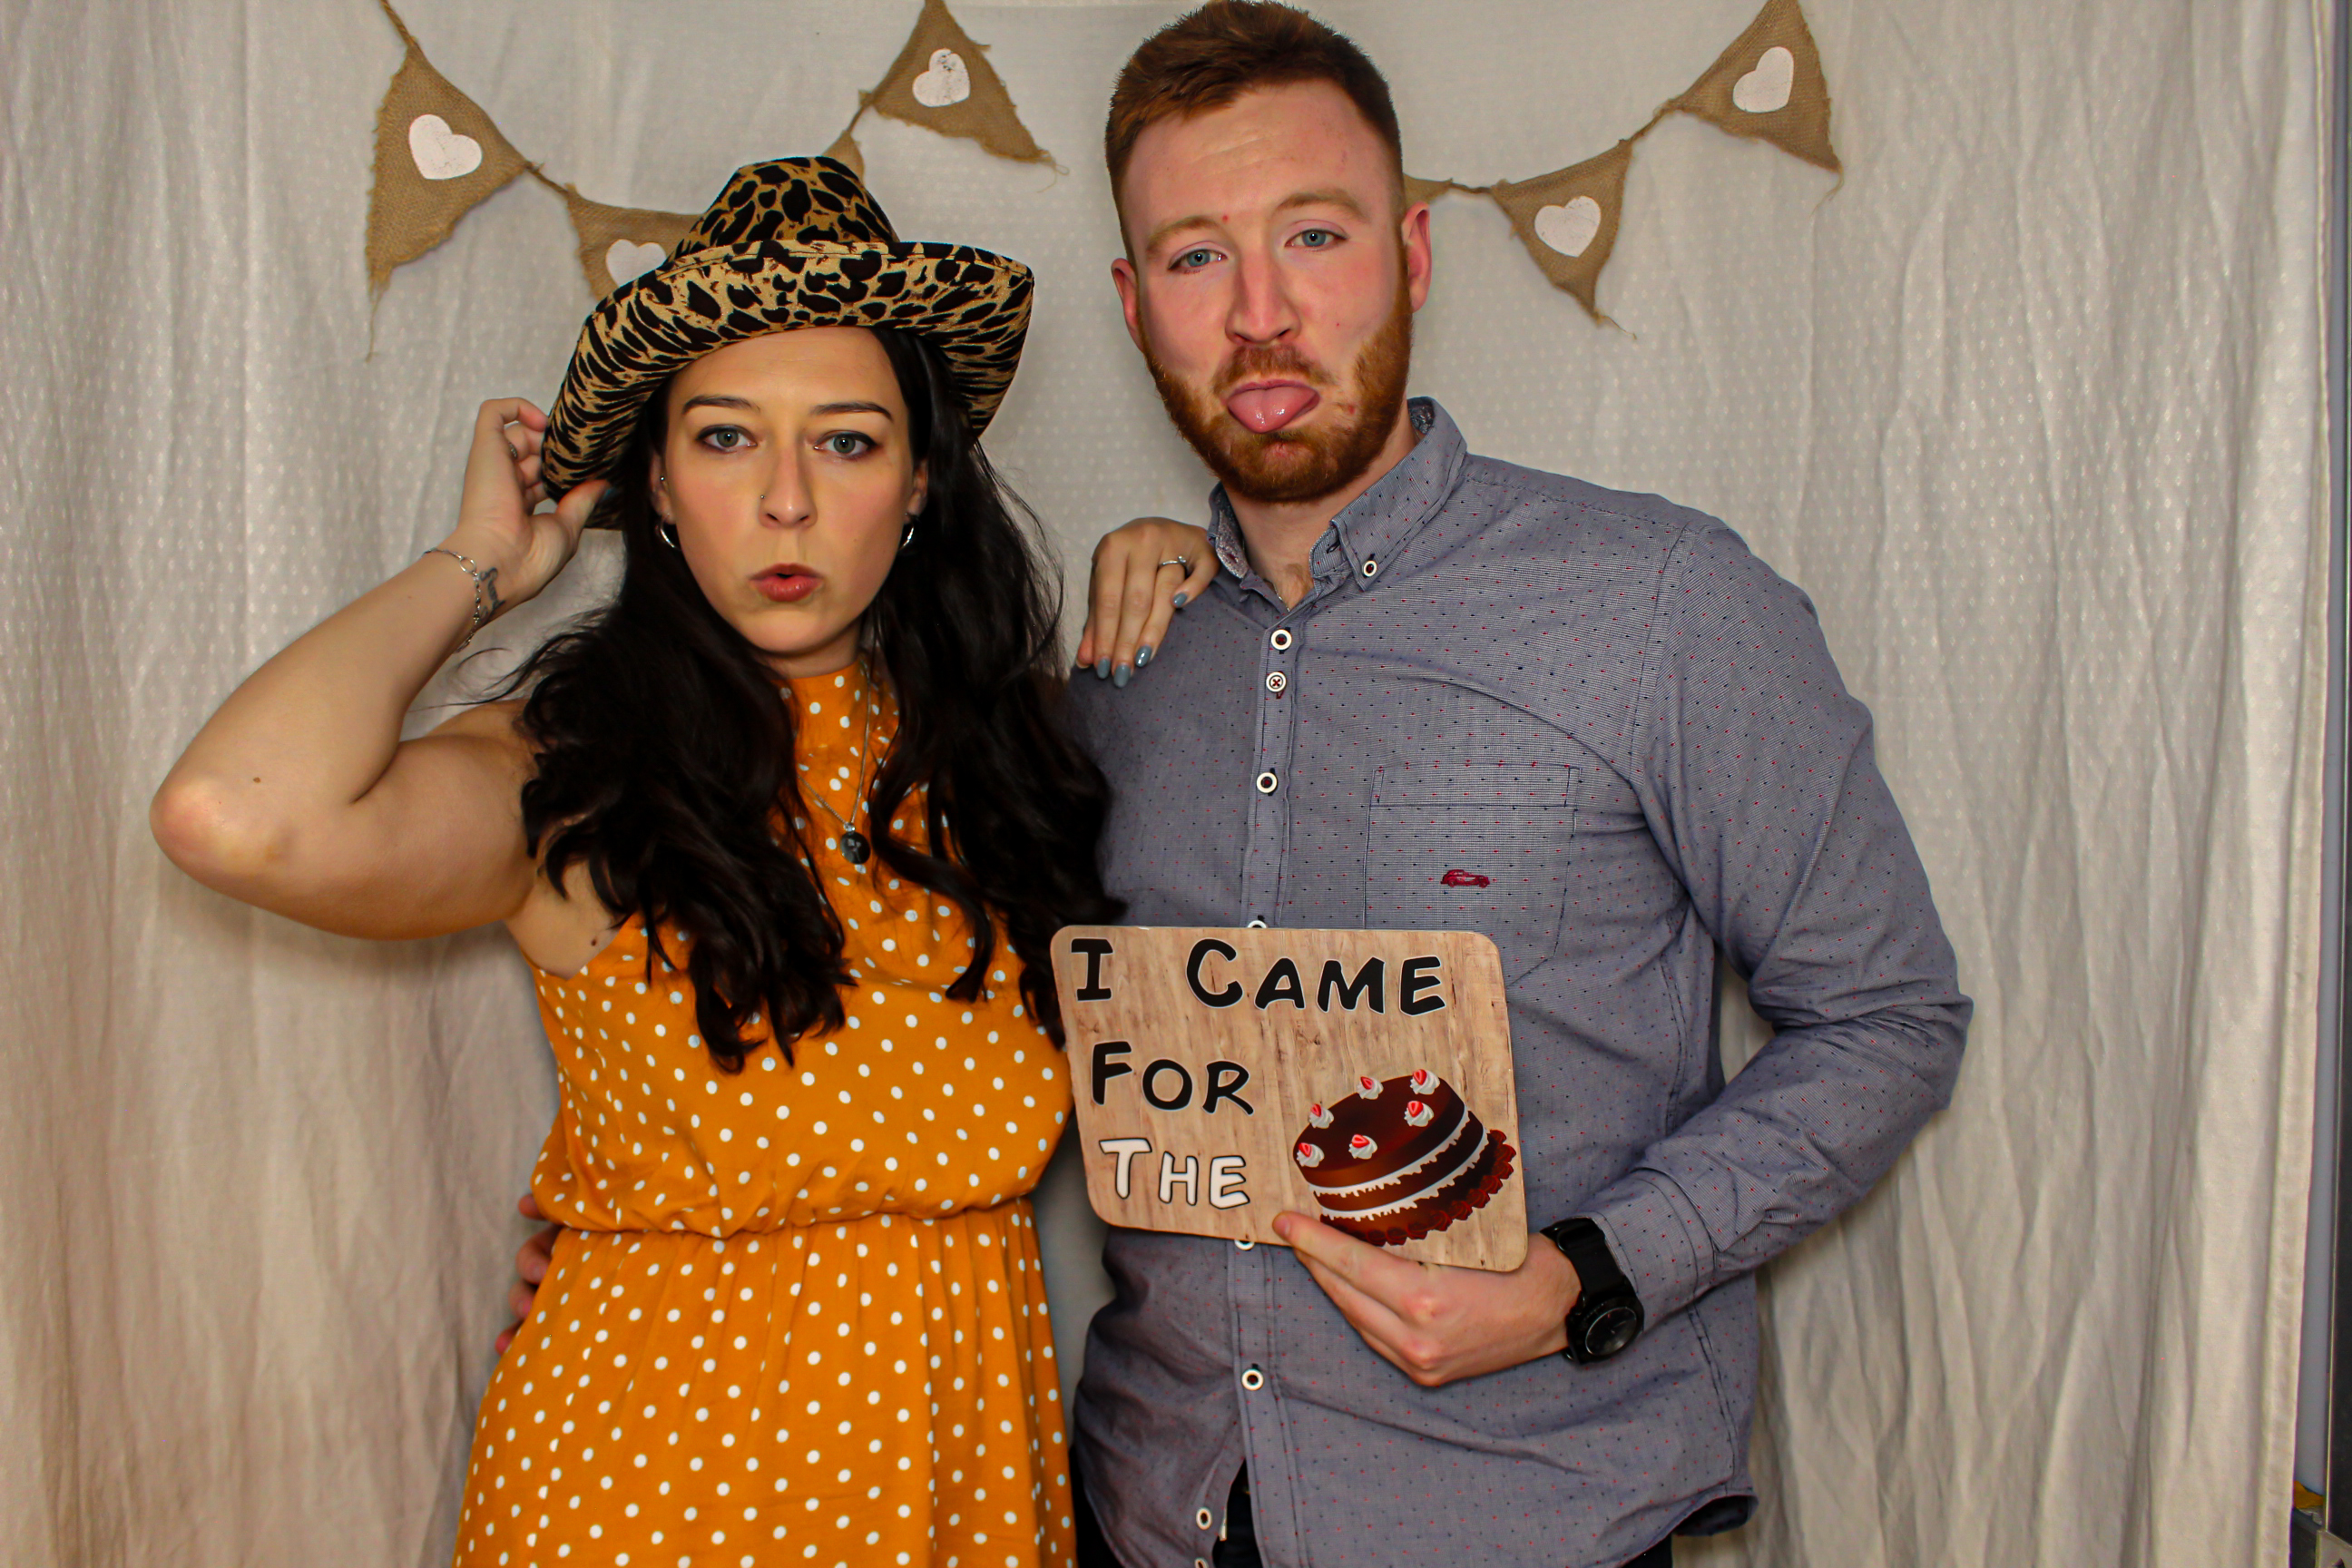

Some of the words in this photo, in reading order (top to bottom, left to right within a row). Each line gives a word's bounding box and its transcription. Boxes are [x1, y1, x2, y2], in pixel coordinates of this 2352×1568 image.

[1071, 938, 1113, 1001] I
[1186, 938, 1446, 1016] CAME
[1092, 1041, 1254, 1115] FOR
[1099, 1138, 1250, 1210] THE
